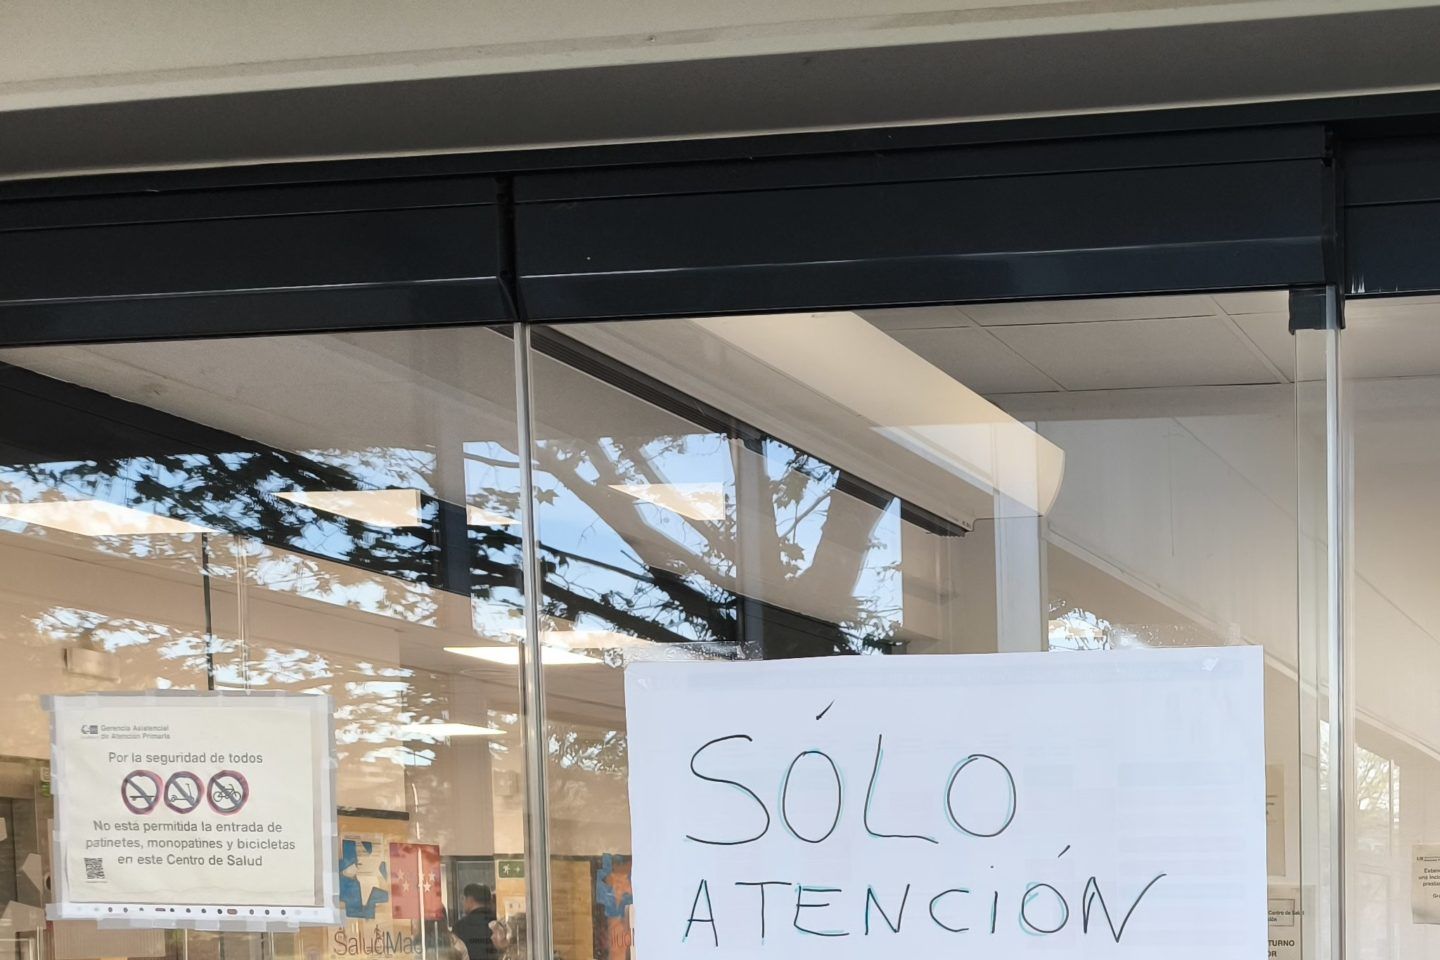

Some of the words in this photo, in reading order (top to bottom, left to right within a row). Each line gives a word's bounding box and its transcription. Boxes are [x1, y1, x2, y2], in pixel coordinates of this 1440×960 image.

[108, 752, 128, 764] Por
[131, 752, 142, 764] la
[146, 752, 207, 766] seguridad
[209, 753, 226, 764] de
[228, 753, 264, 765] todos
[685, 701, 1017, 846] SÓLO
[93, 820, 111, 832] No
[114, 820, 140, 832] está
[143, 820, 198, 834] permitida
[201, 820, 213, 833] la
[215, 821, 264, 834] entrada
[266, 822, 283, 834] de
[85, 837, 144, 850] patinetes,
[147, 837, 223, 851] monopatines
[226, 840, 234, 852] y
[237, 838, 296, 851] bicicletas
[117, 856, 134, 866] en
[137, 855, 163, 866] este
[166, 854, 206, 867] Centro
[208, 855, 224, 867] de
[226, 854, 263, 868] Salud
[681, 845, 1167, 946] ATENCIÓN
